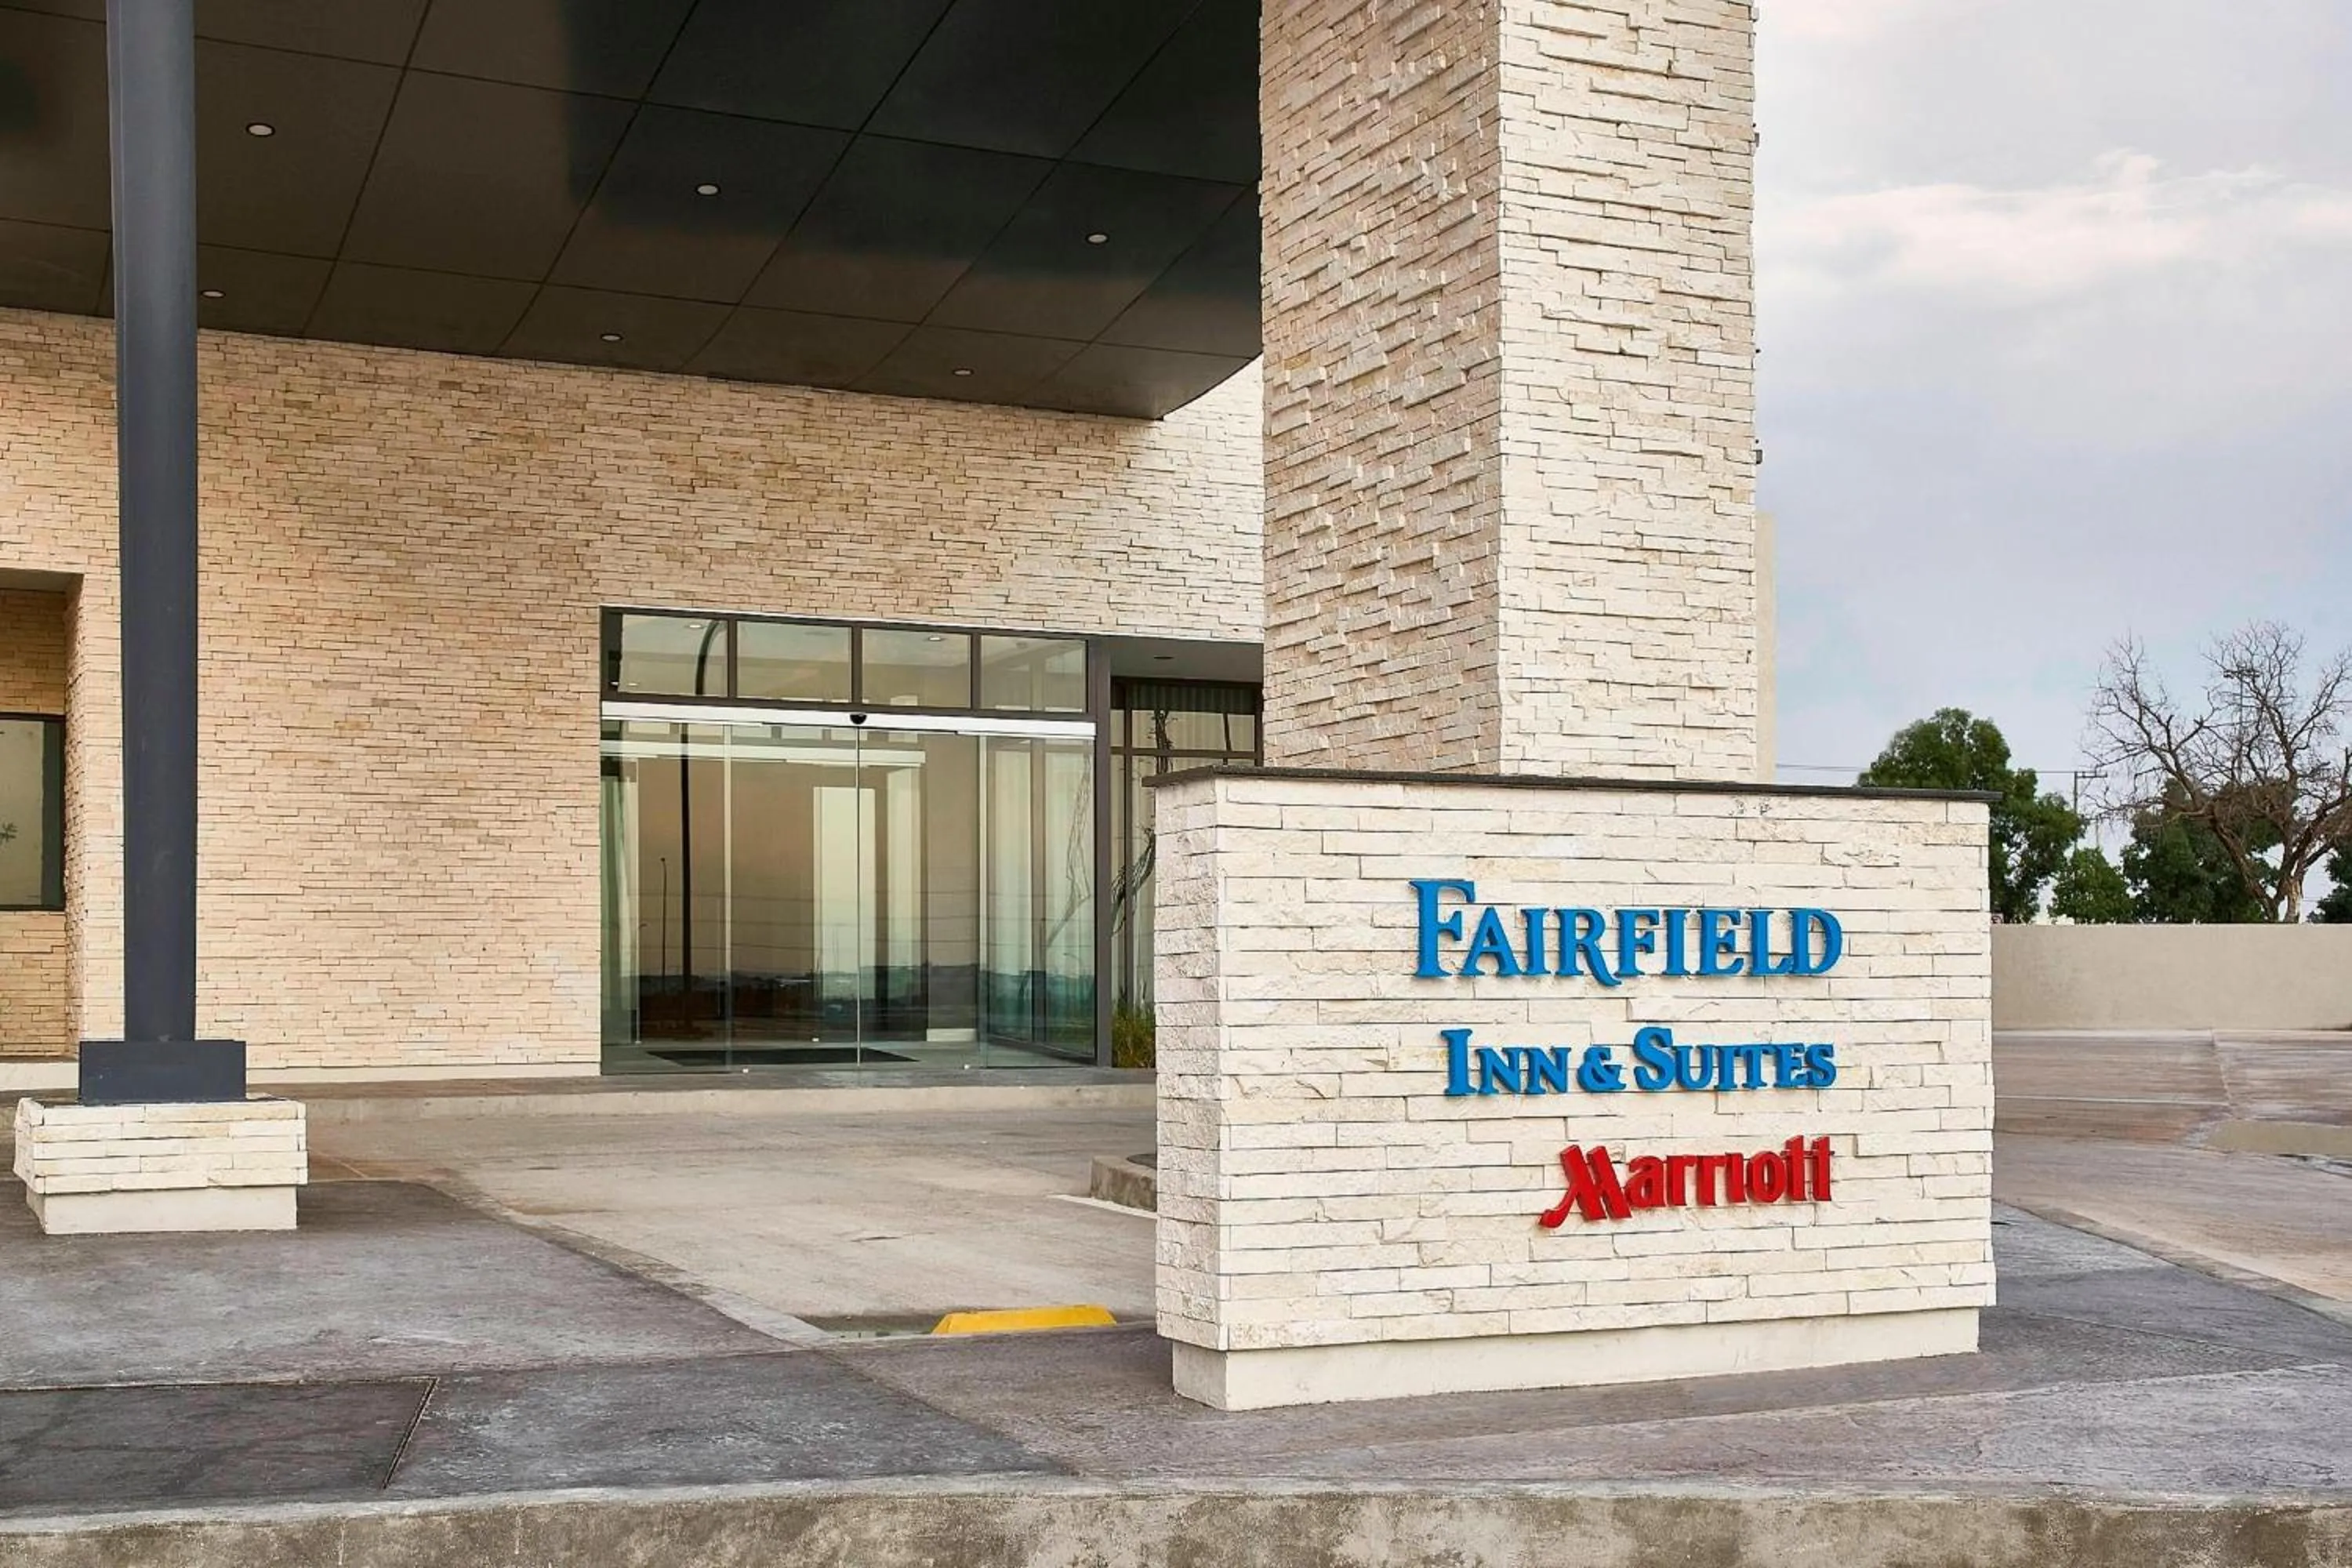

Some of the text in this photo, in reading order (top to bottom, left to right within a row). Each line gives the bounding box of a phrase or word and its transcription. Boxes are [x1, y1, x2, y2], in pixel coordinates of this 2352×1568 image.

[1410, 880, 1843, 986] FAIRFIELD
[1441, 1027, 1837, 1096] INN & SUITES
[1538, 1135, 1834, 1229] Marriott
